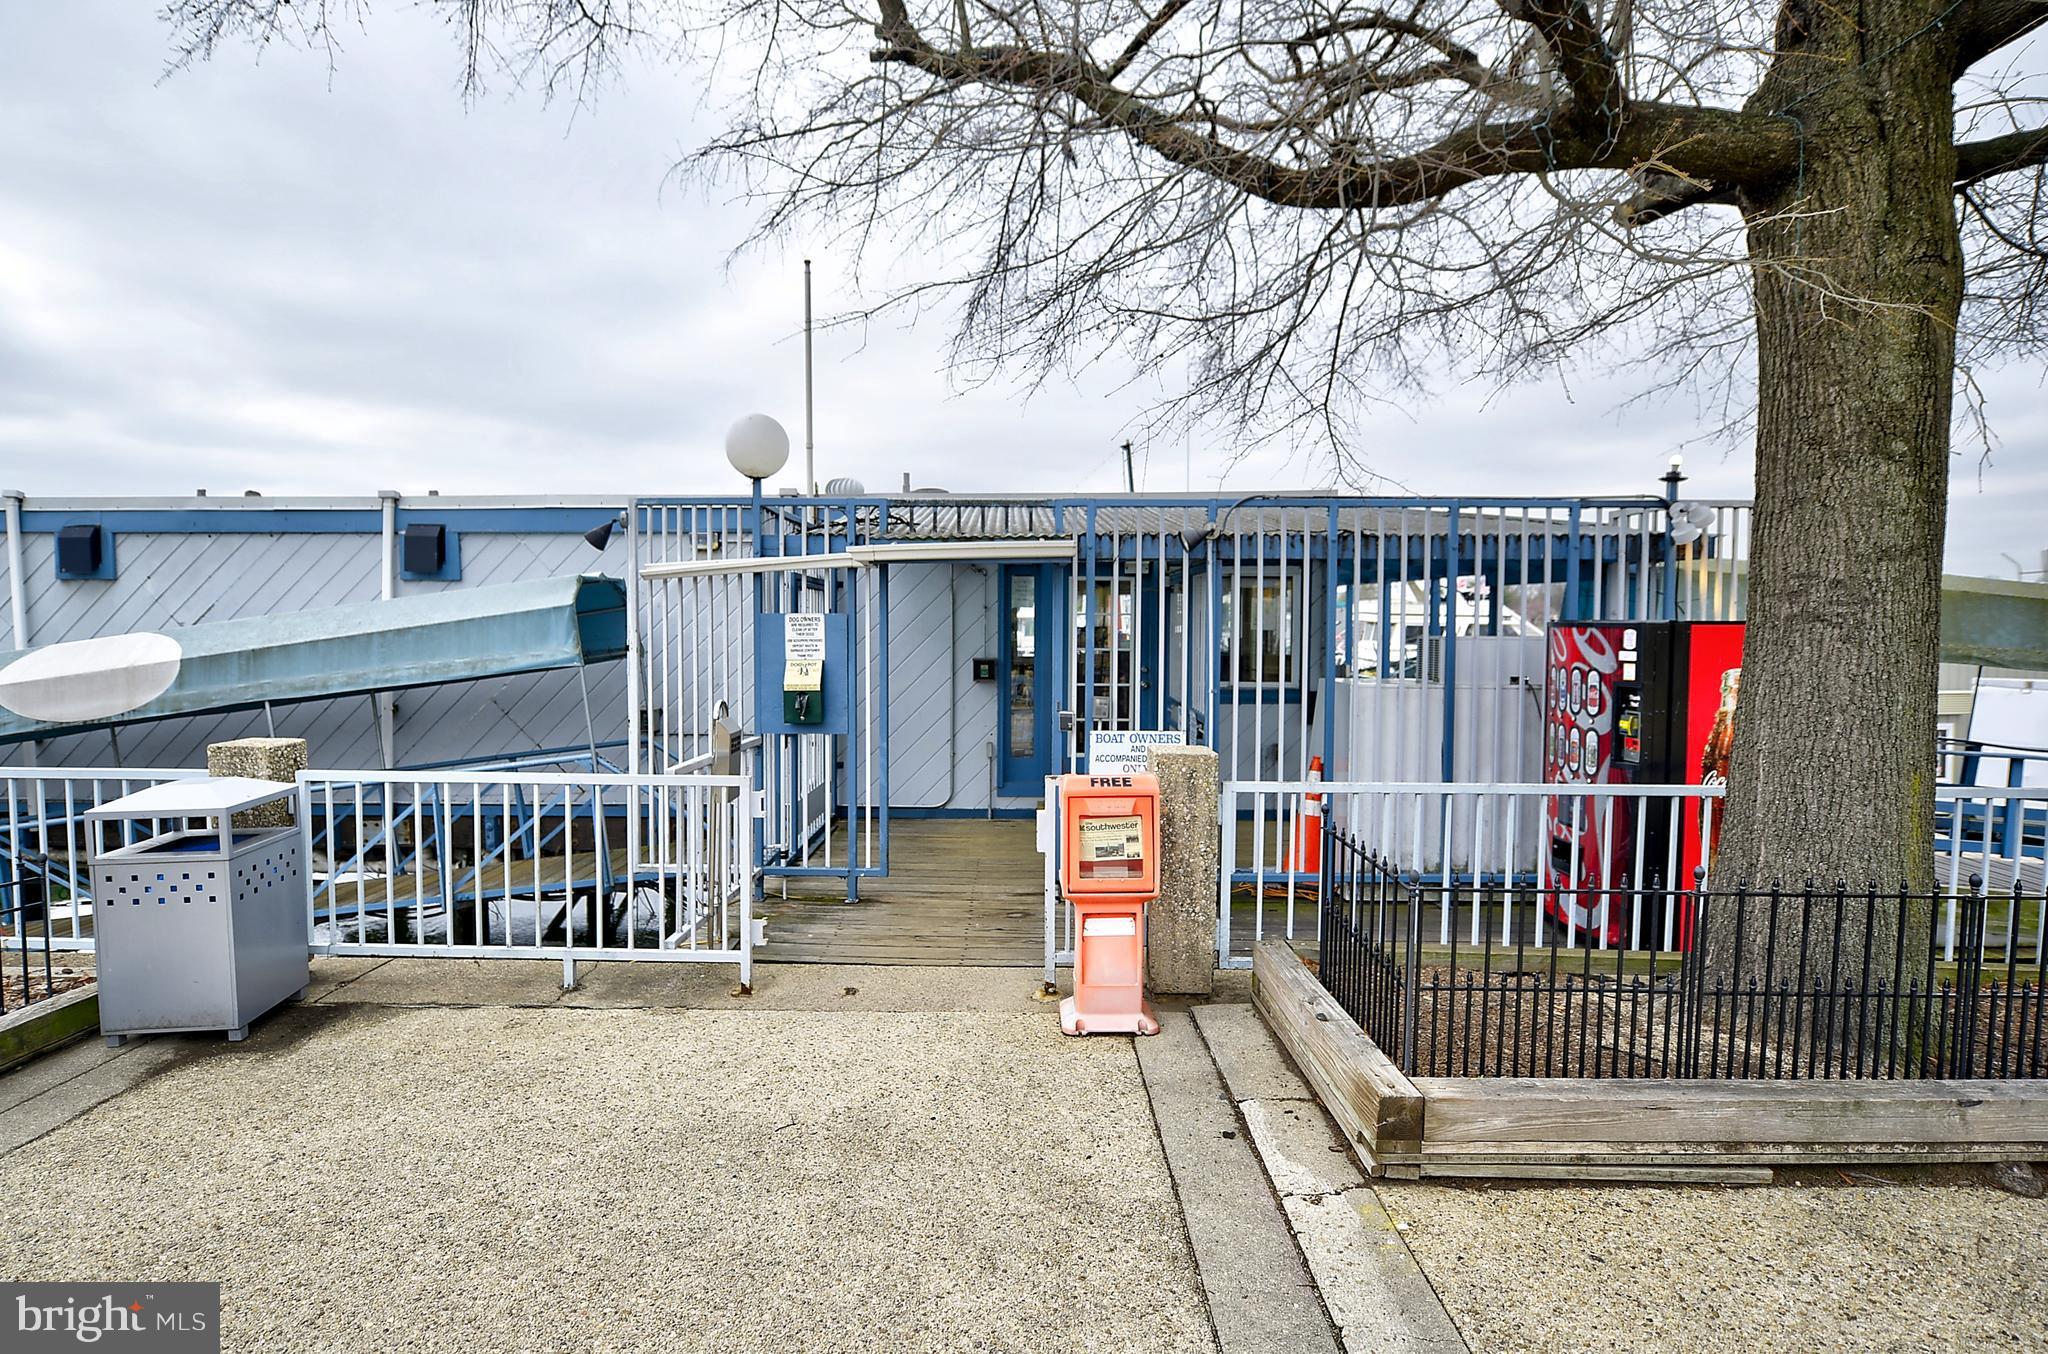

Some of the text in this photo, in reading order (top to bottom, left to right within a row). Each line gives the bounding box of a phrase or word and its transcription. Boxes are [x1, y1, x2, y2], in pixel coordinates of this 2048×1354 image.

[1095, 733, 1181, 744] BOAT OWNERS
[1130, 745, 1146, 753] AND
[1095, 754, 1148, 763] ACCOMPANIED
[1090, 777, 1132, 787] FREE
[1085, 822, 1138, 831] southwester
